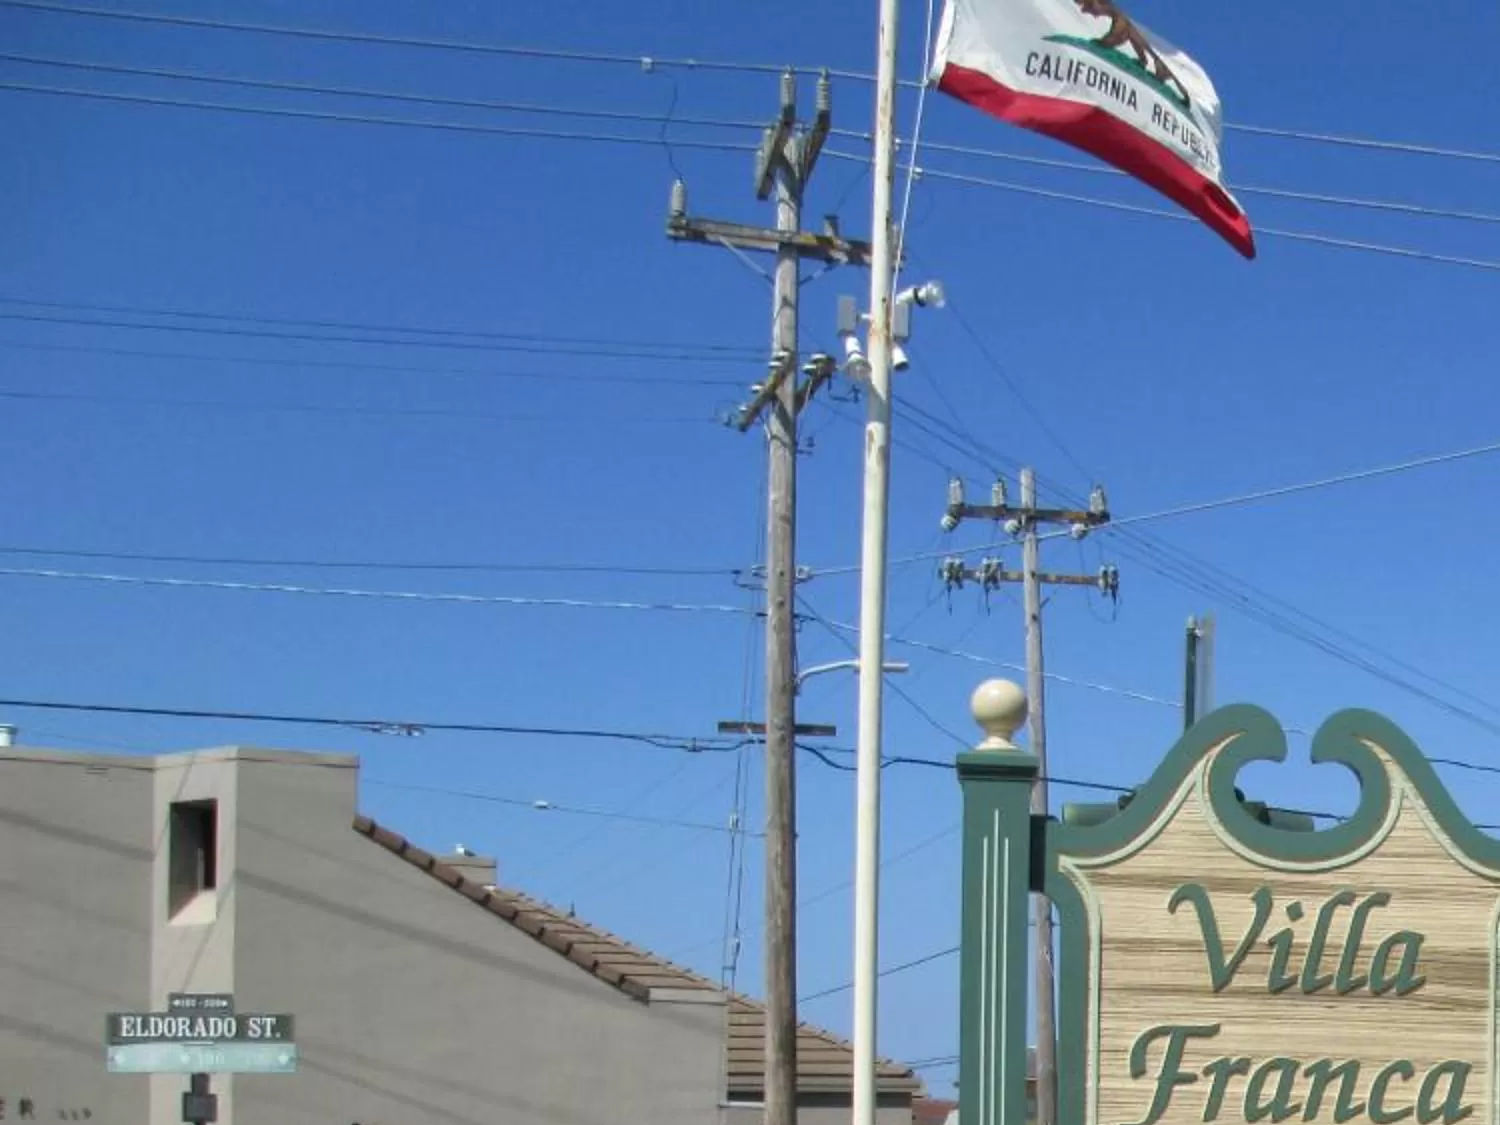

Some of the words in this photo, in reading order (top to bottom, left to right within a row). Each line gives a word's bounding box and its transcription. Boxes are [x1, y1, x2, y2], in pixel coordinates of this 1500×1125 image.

[1025, 51, 1139, 113] CALIFORNIA
[1167, 882, 1427, 997] Villa
[120, 1015, 237, 1038] ELDORADO
[247, 1016, 281, 1038] ST.
